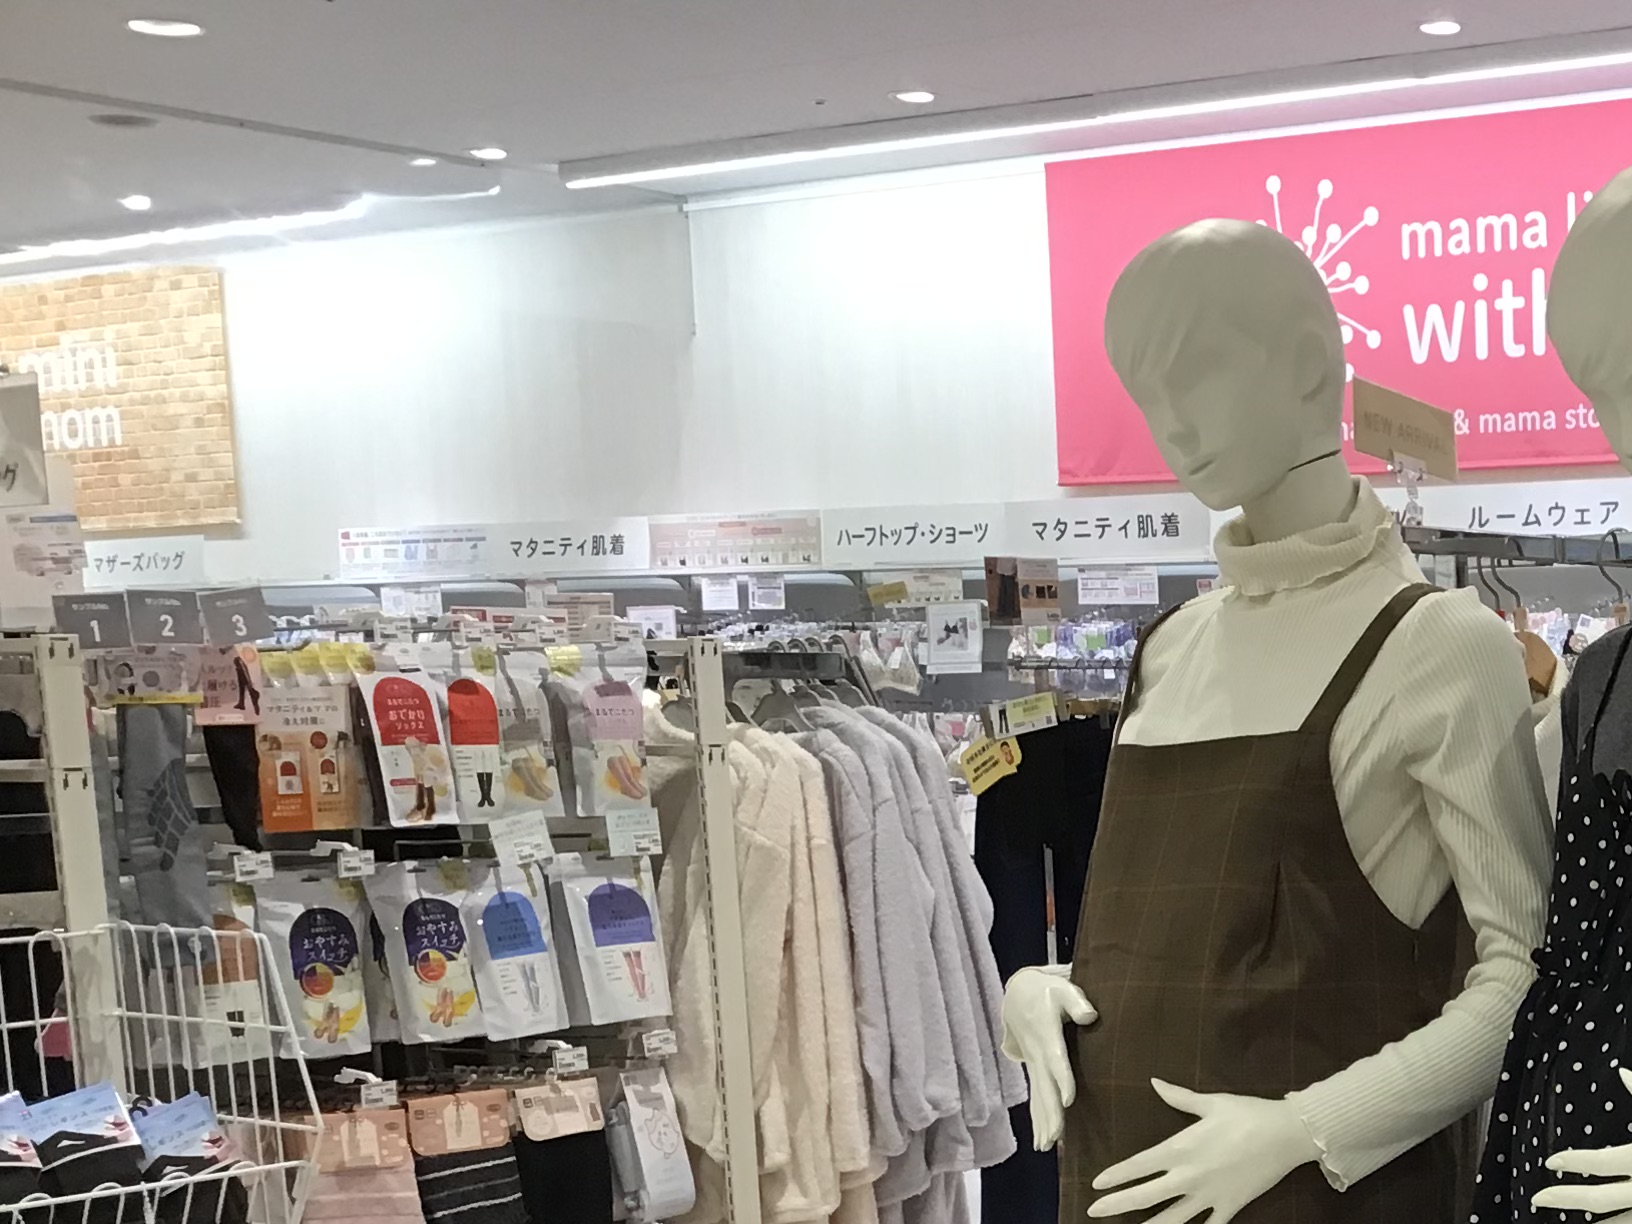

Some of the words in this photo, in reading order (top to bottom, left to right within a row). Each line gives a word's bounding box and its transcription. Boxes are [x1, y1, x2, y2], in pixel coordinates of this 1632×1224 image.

[1401, 210, 1549, 261] mama
[1363, 409, 1393, 438] NEW
[1453, 408, 1471, 436] &
[1479, 407, 1557, 434] mama
[1031, 511, 1181, 542] マタニティ肌着
[1468, 500, 1620, 530] ルームウェア
[509, 532, 626, 559] マタニティ肌着
[836, 522, 990, 547] ハーフトップ・ショーツ
[92, 550, 186, 574] マザーズバッグ
[89, 619, 102, 643] 1
[158, 613, 176, 638] 2
[231, 613, 248, 637] 3
